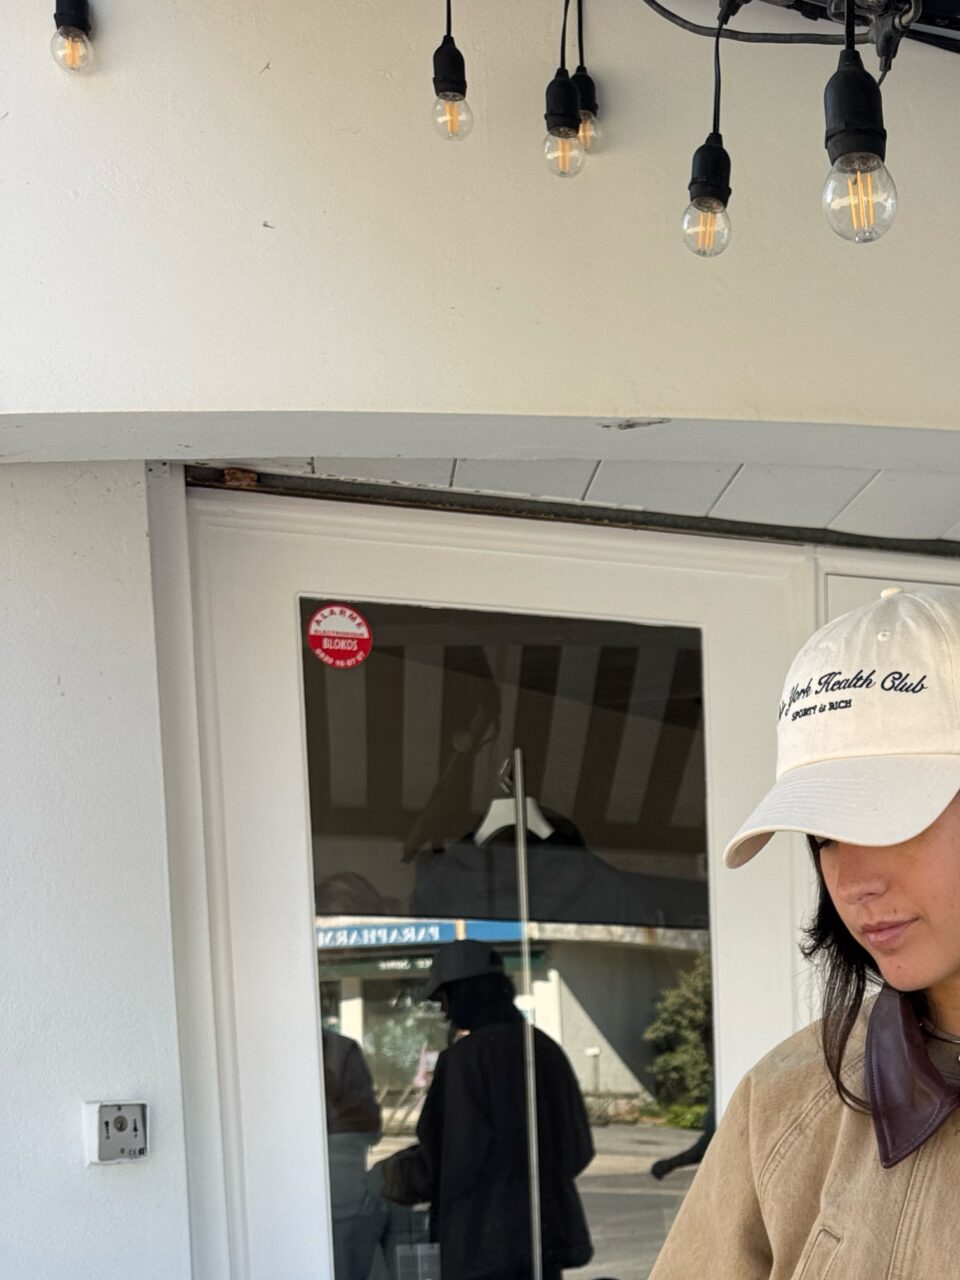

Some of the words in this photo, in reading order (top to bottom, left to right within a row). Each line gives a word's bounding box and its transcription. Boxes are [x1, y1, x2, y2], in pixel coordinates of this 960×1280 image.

[315, 609, 365, 629] ALARME
[322, 638, 358, 650] BLOKOS
[814, 669, 876, 695] Health
[880, 671, 928, 694] Club
[791, 704, 818, 722] SPORTY
[828, 699, 852, 711] RICH
